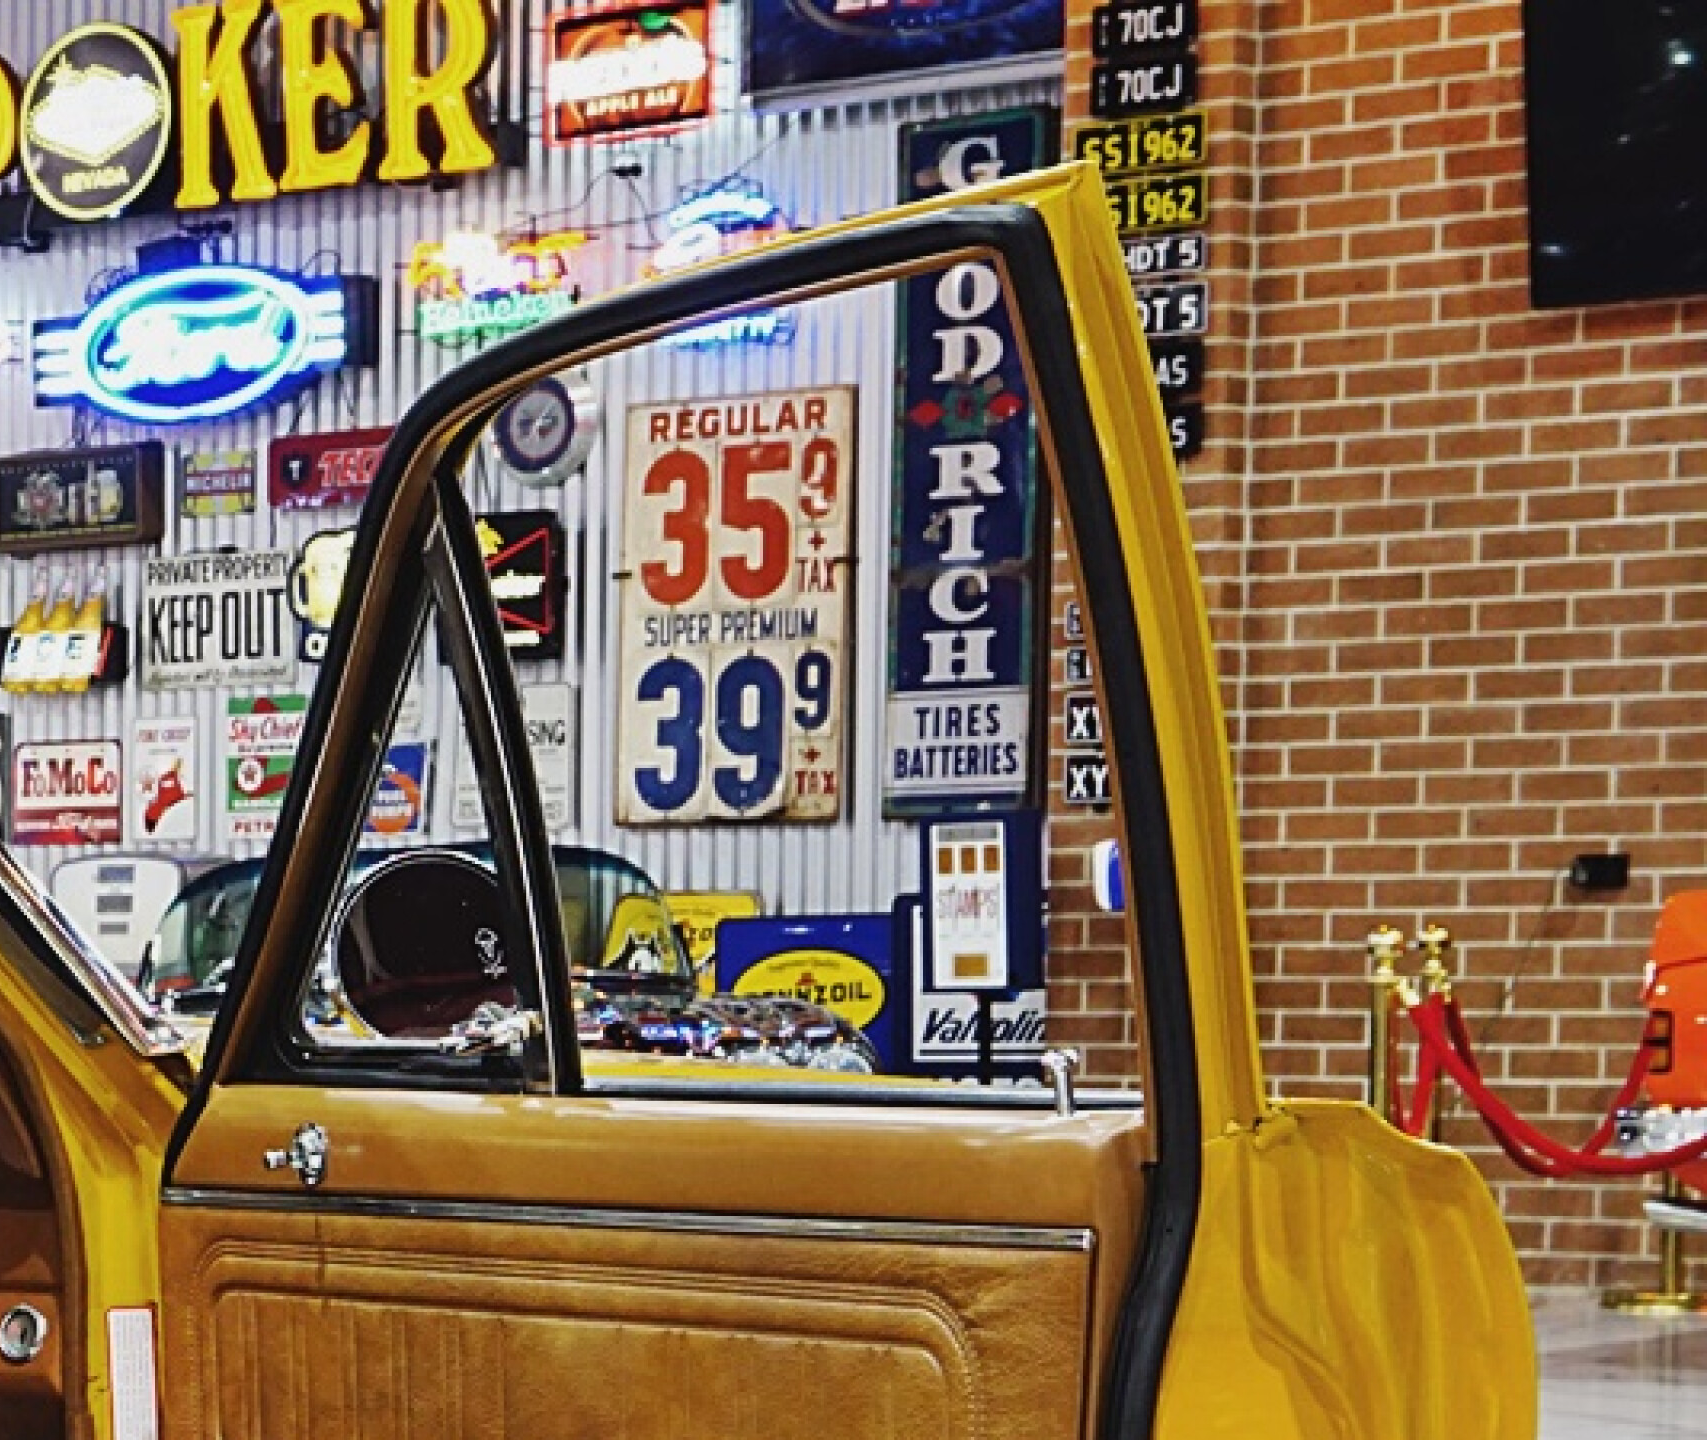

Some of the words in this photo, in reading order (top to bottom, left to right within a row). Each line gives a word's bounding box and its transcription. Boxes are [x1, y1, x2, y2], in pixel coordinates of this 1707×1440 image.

[1117, 3, 1184, 44] 70CJ
[1115, 64, 1184, 103] 70CJ
[1106, 186, 1196, 227] S1962
[97, 300, 281, 391] Ford
[650, 397, 827, 443] REGULAR
[148, 559, 212, 586] PRIVATE
[213, 553, 288, 583] PROPERTY
[795, 556, 837, 593] TAX
[148, 594, 214, 666] KEEP
[221, 588, 287, 661] OUT
[644, 611, 710, 647] SUPER
[720, 607, 819, 641] PREMIUM
[527, 718, 566, 746] SING
[914, 702, 1001, 740] TIRES
[22, 757, 118, 798] FoMoCo
[893, 741, 1019, 780] BATTERIES
[794, 769, 835, 795] TAX
[233, 820, 274, 834] PETR
[922, 1006, 1045, 1044] Valolin
